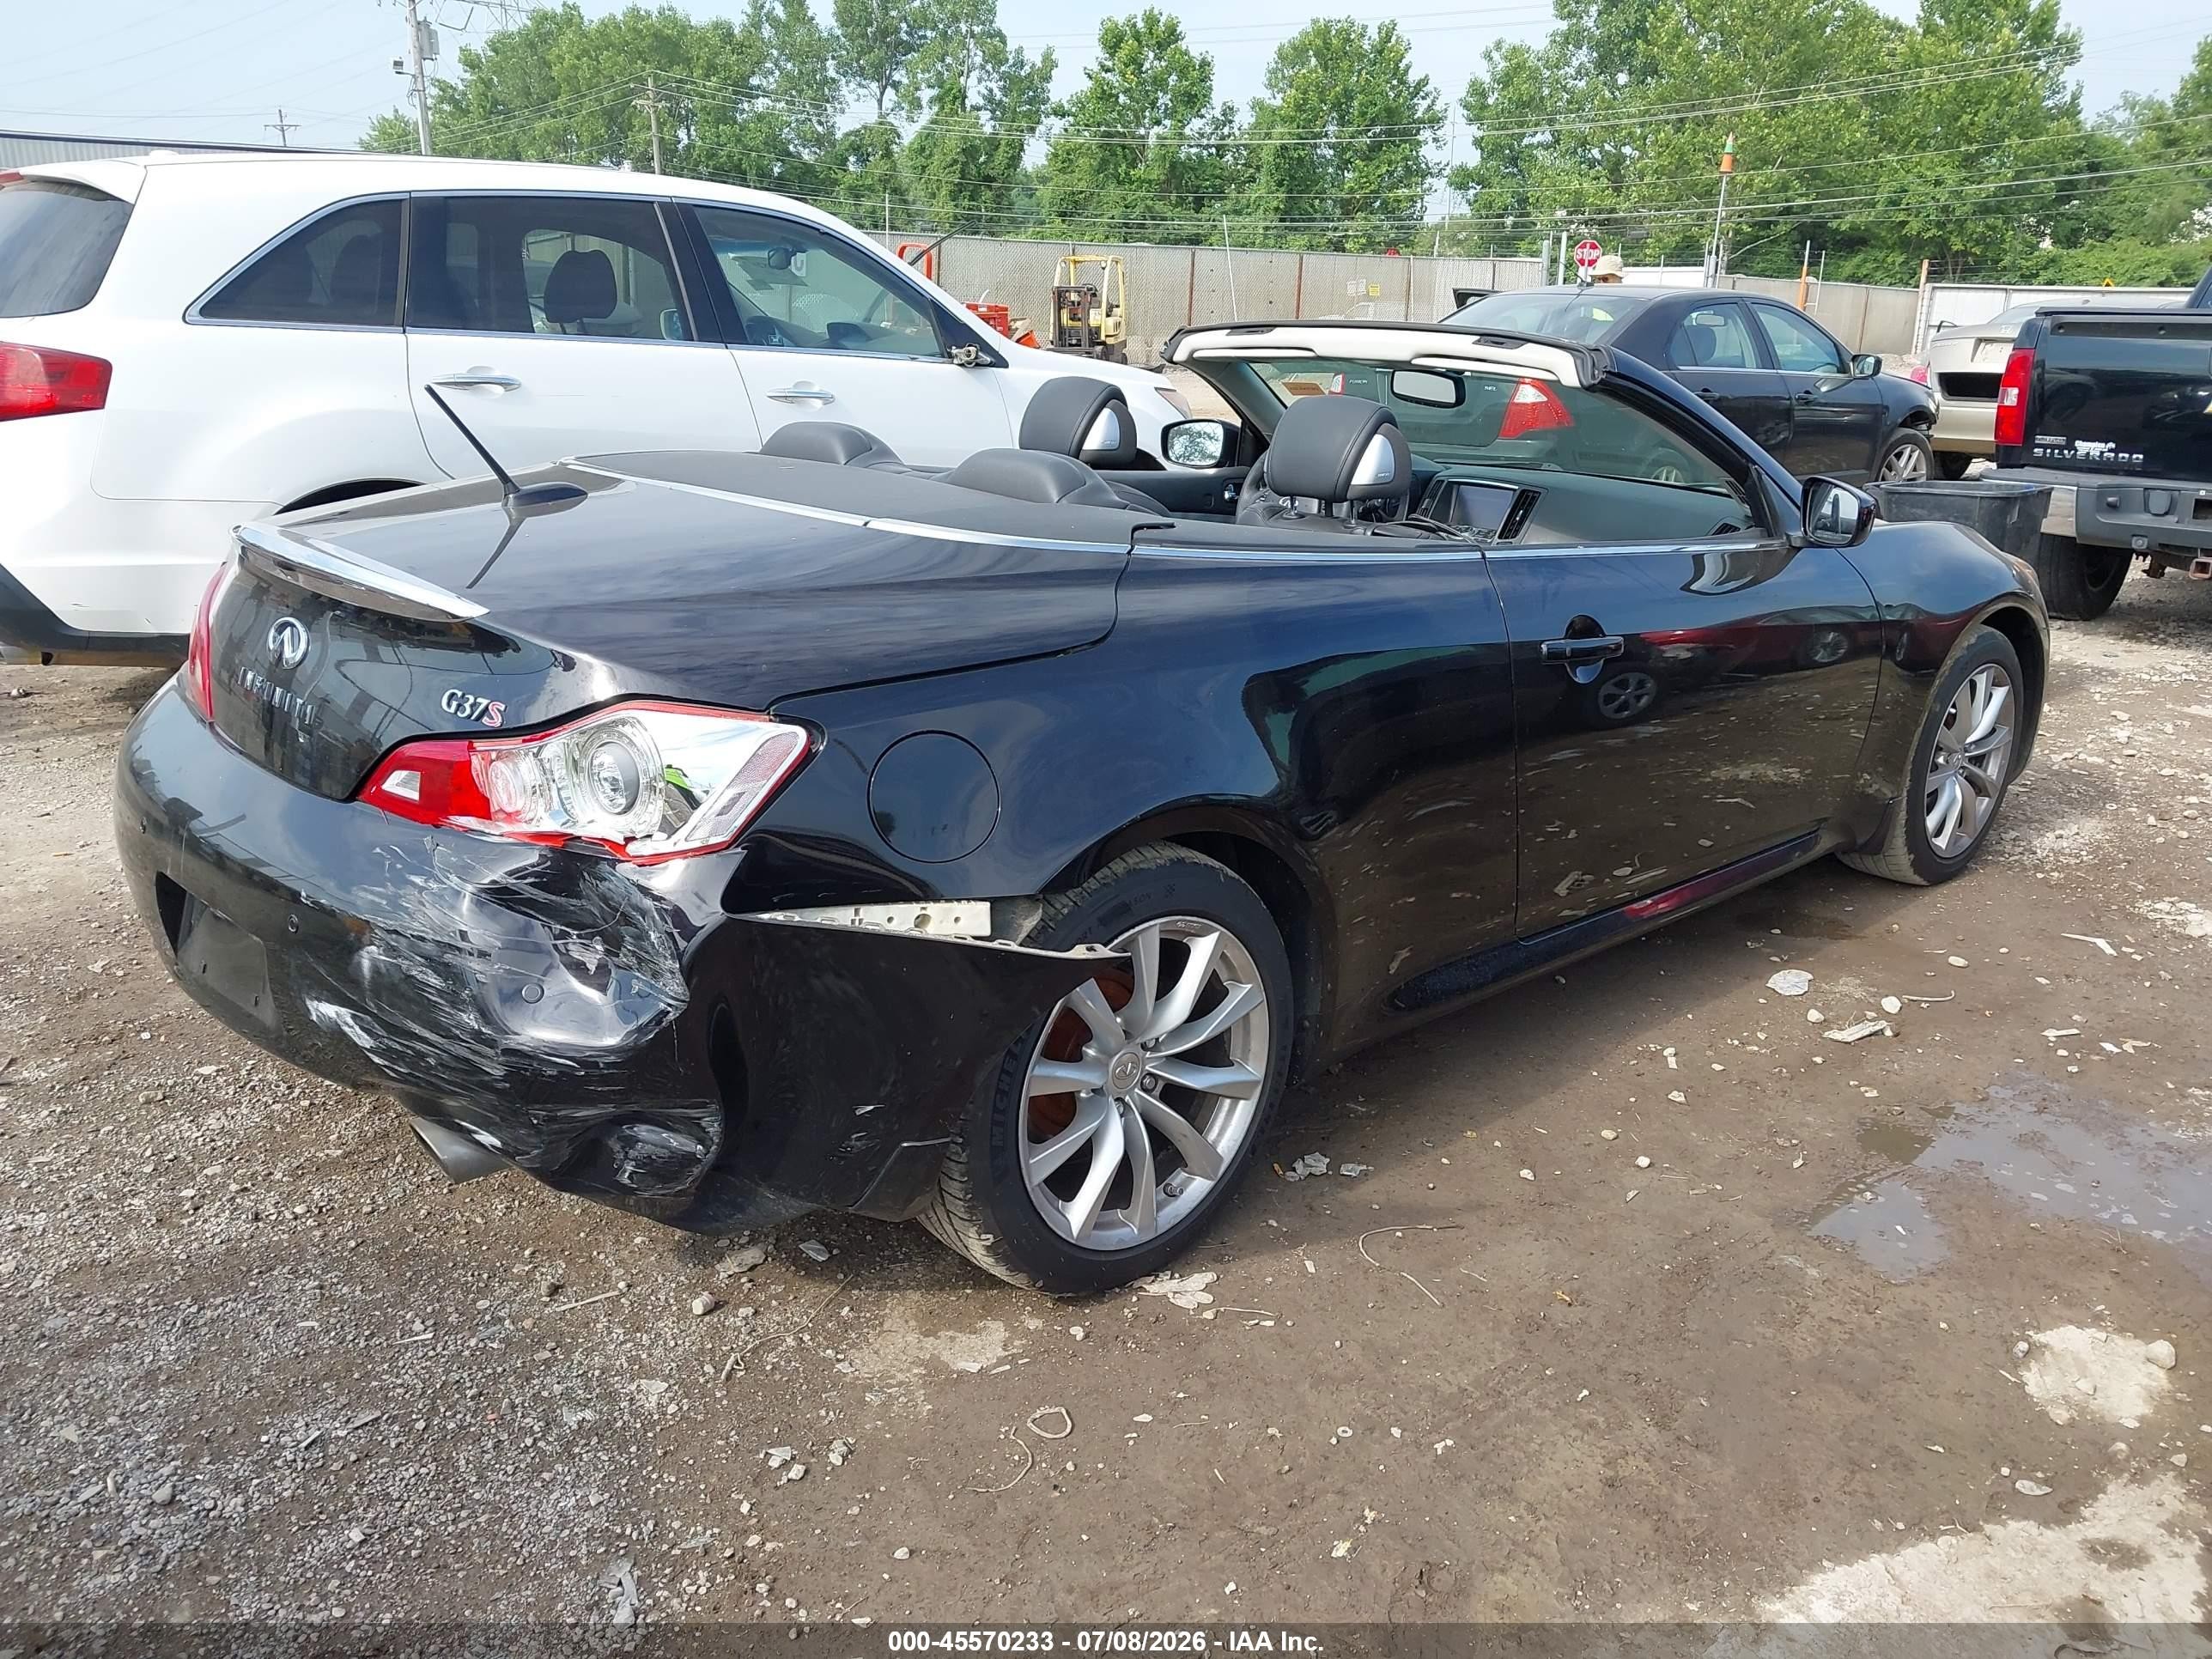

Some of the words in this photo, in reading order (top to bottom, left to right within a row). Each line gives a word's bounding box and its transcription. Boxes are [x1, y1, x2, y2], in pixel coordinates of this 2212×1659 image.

[1576, 248, 1601, 259] STOP
[2033, 447, 2144, 464] SILVERADO
[237, 665, 316, 726] INFINITI
[441, 688, 507, 728] G37S
